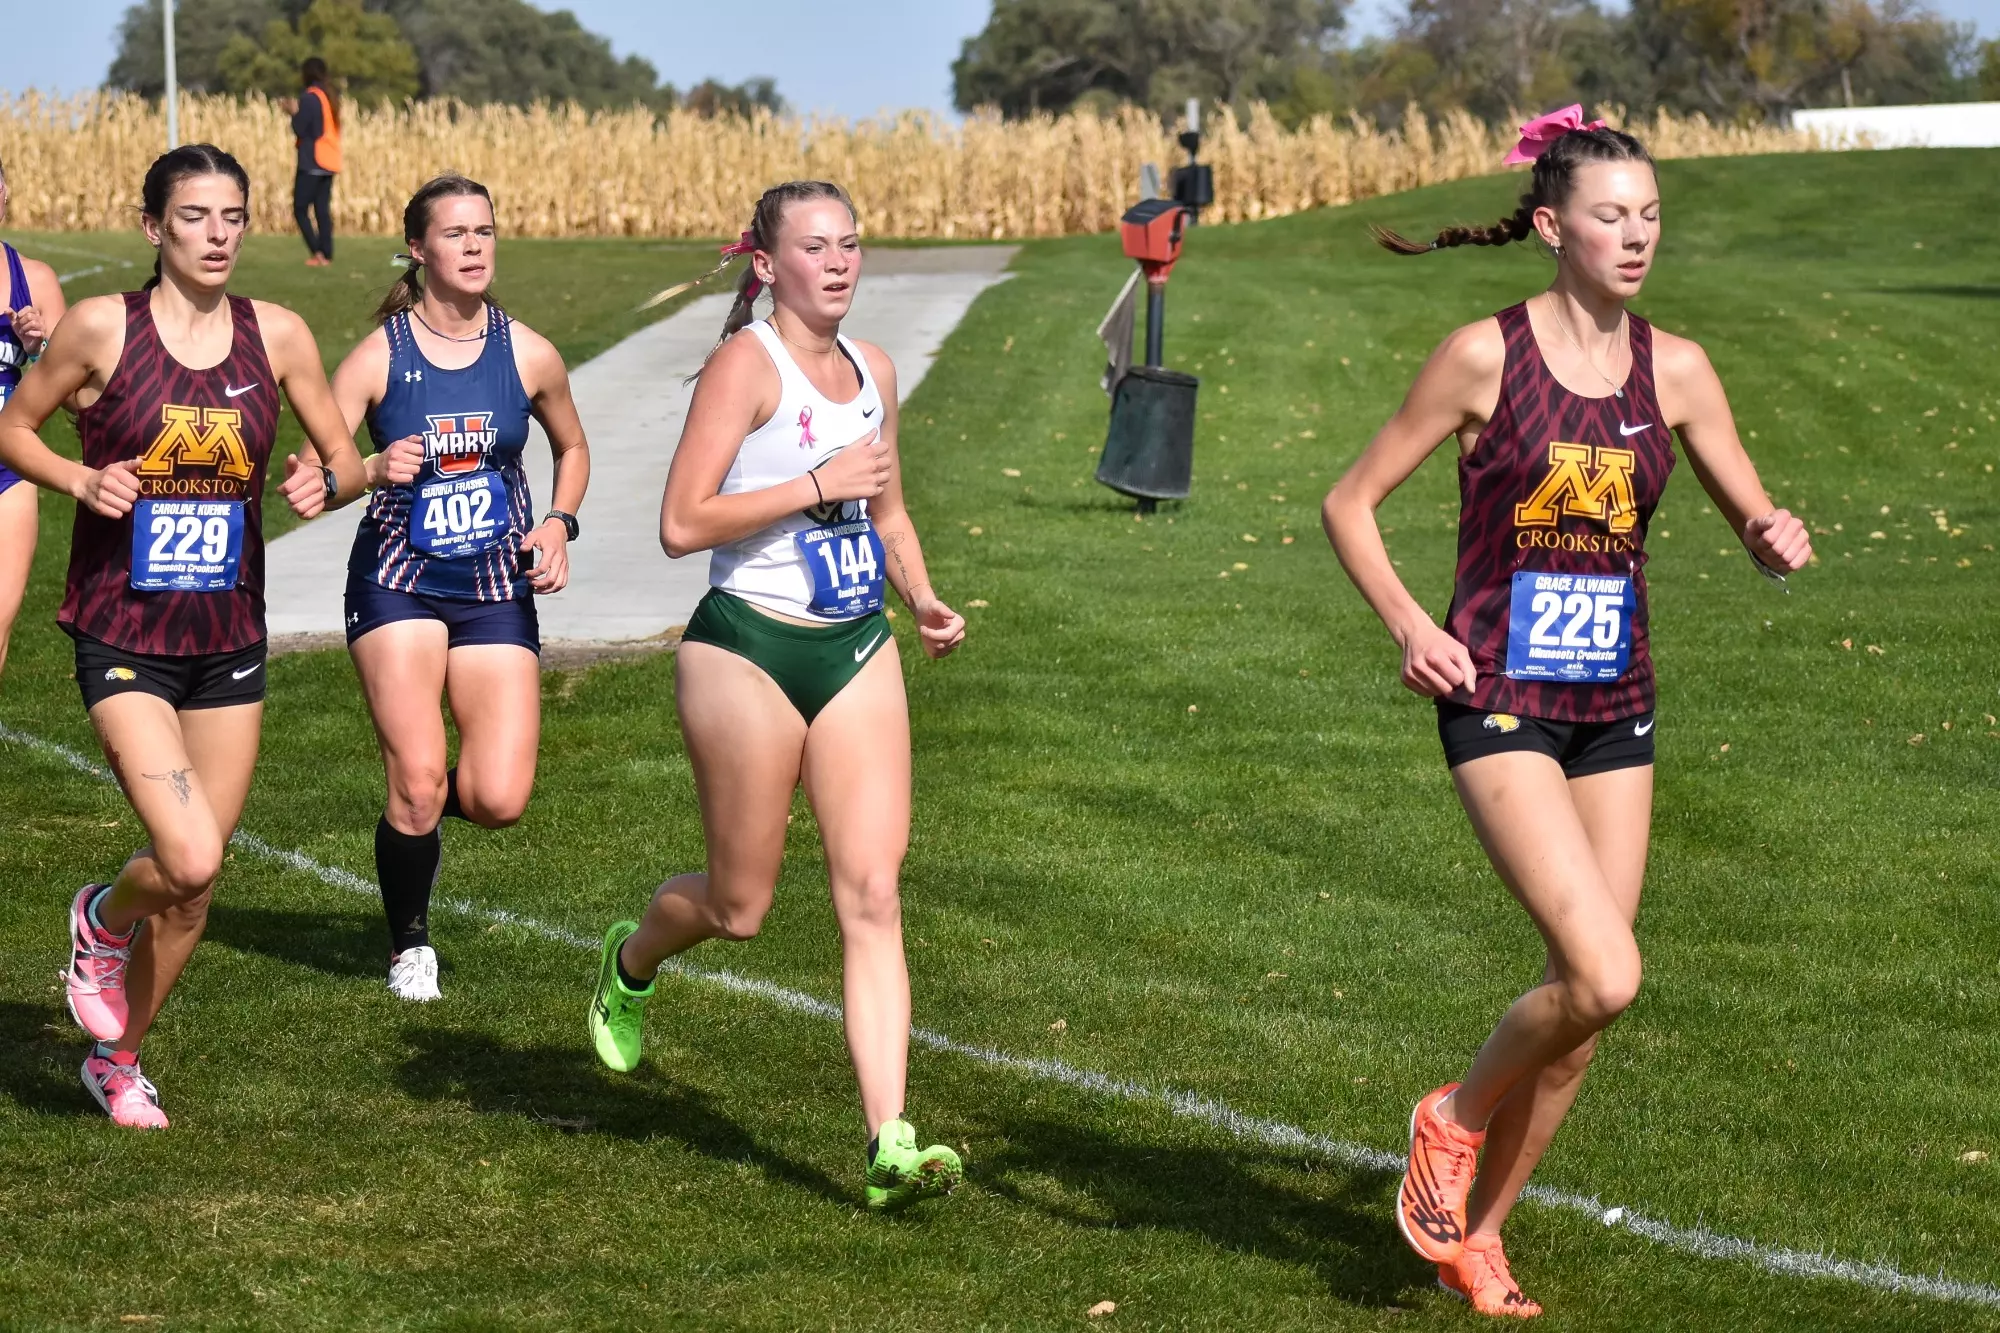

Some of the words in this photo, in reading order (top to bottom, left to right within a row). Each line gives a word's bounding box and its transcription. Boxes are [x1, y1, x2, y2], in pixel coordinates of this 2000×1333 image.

[429, 430, 493, 457] MARY
[139, 479, 247, 495] CROOKSTON
[421, 484, 453, 498] GIANNA
[151, 503, 196, 515] CAROLINE
[423, 489, 495, 536] 402
[148, 516, 229, 562] 229
[431, 533, 466, 547] University
[467, 532, 475, 540] of
[476, 529, 493, 540] Mary
[148, 563, 186, 573] Minnesota
[187, 564, 225, 574] Crookston
[817, 535, 877, 588] 144
[1535, 576, 1573, 592] GRACE
[1573, 578, 1627, 594] ALWARDT
[1529, 591, 1624, 649] 225
[1529, 647, 1576, 660] Minnesota
[1576, 649, 1618, 661] Crookston
